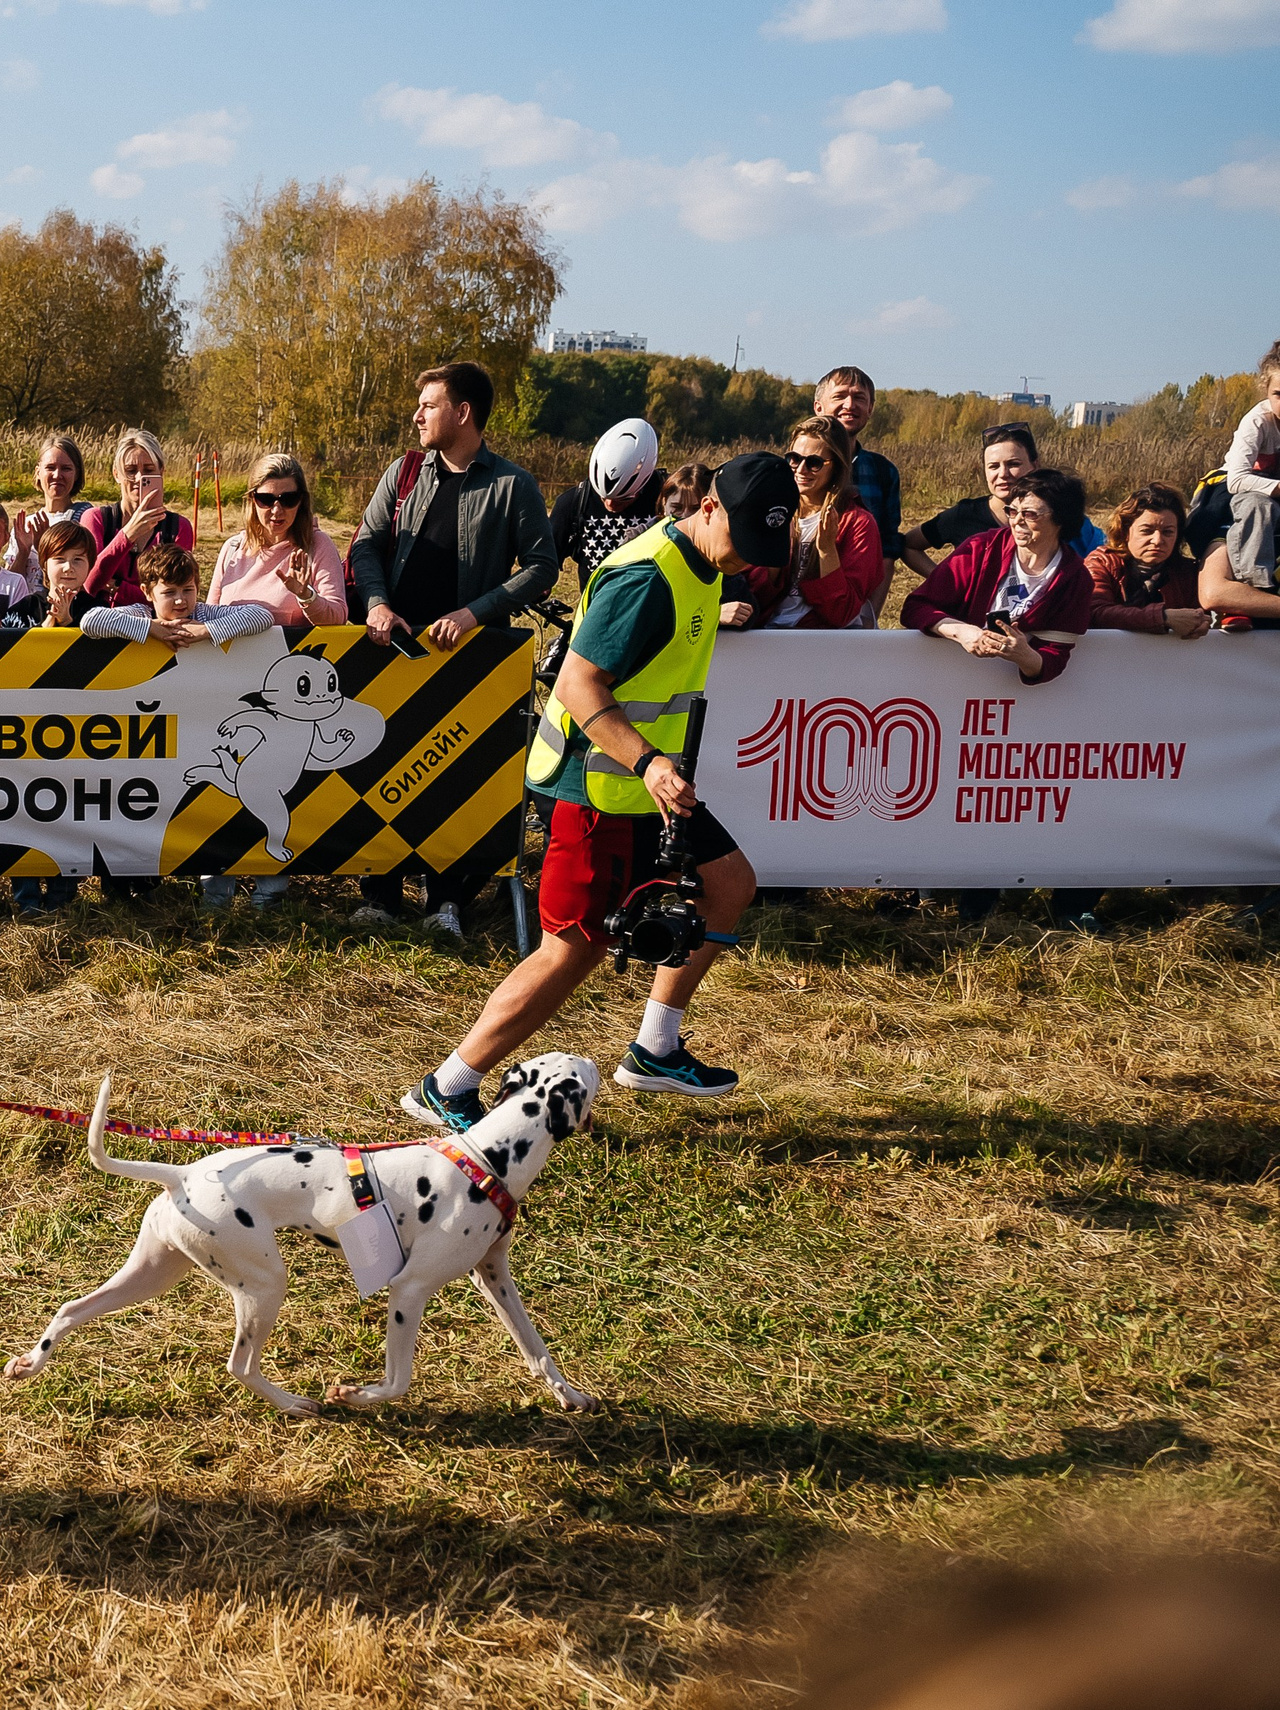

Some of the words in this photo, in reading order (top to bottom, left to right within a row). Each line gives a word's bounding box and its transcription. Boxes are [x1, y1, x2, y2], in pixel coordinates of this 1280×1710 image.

[959, 698, 1017, 736] ЛЕТ
[378, 720, 470, 805] билайн
[736, 696, 942, 822] 100
[957, 742, 1187, 781] МОСКОВСКОМУ
[954, 786, 1072, 824] СПОРТУ
